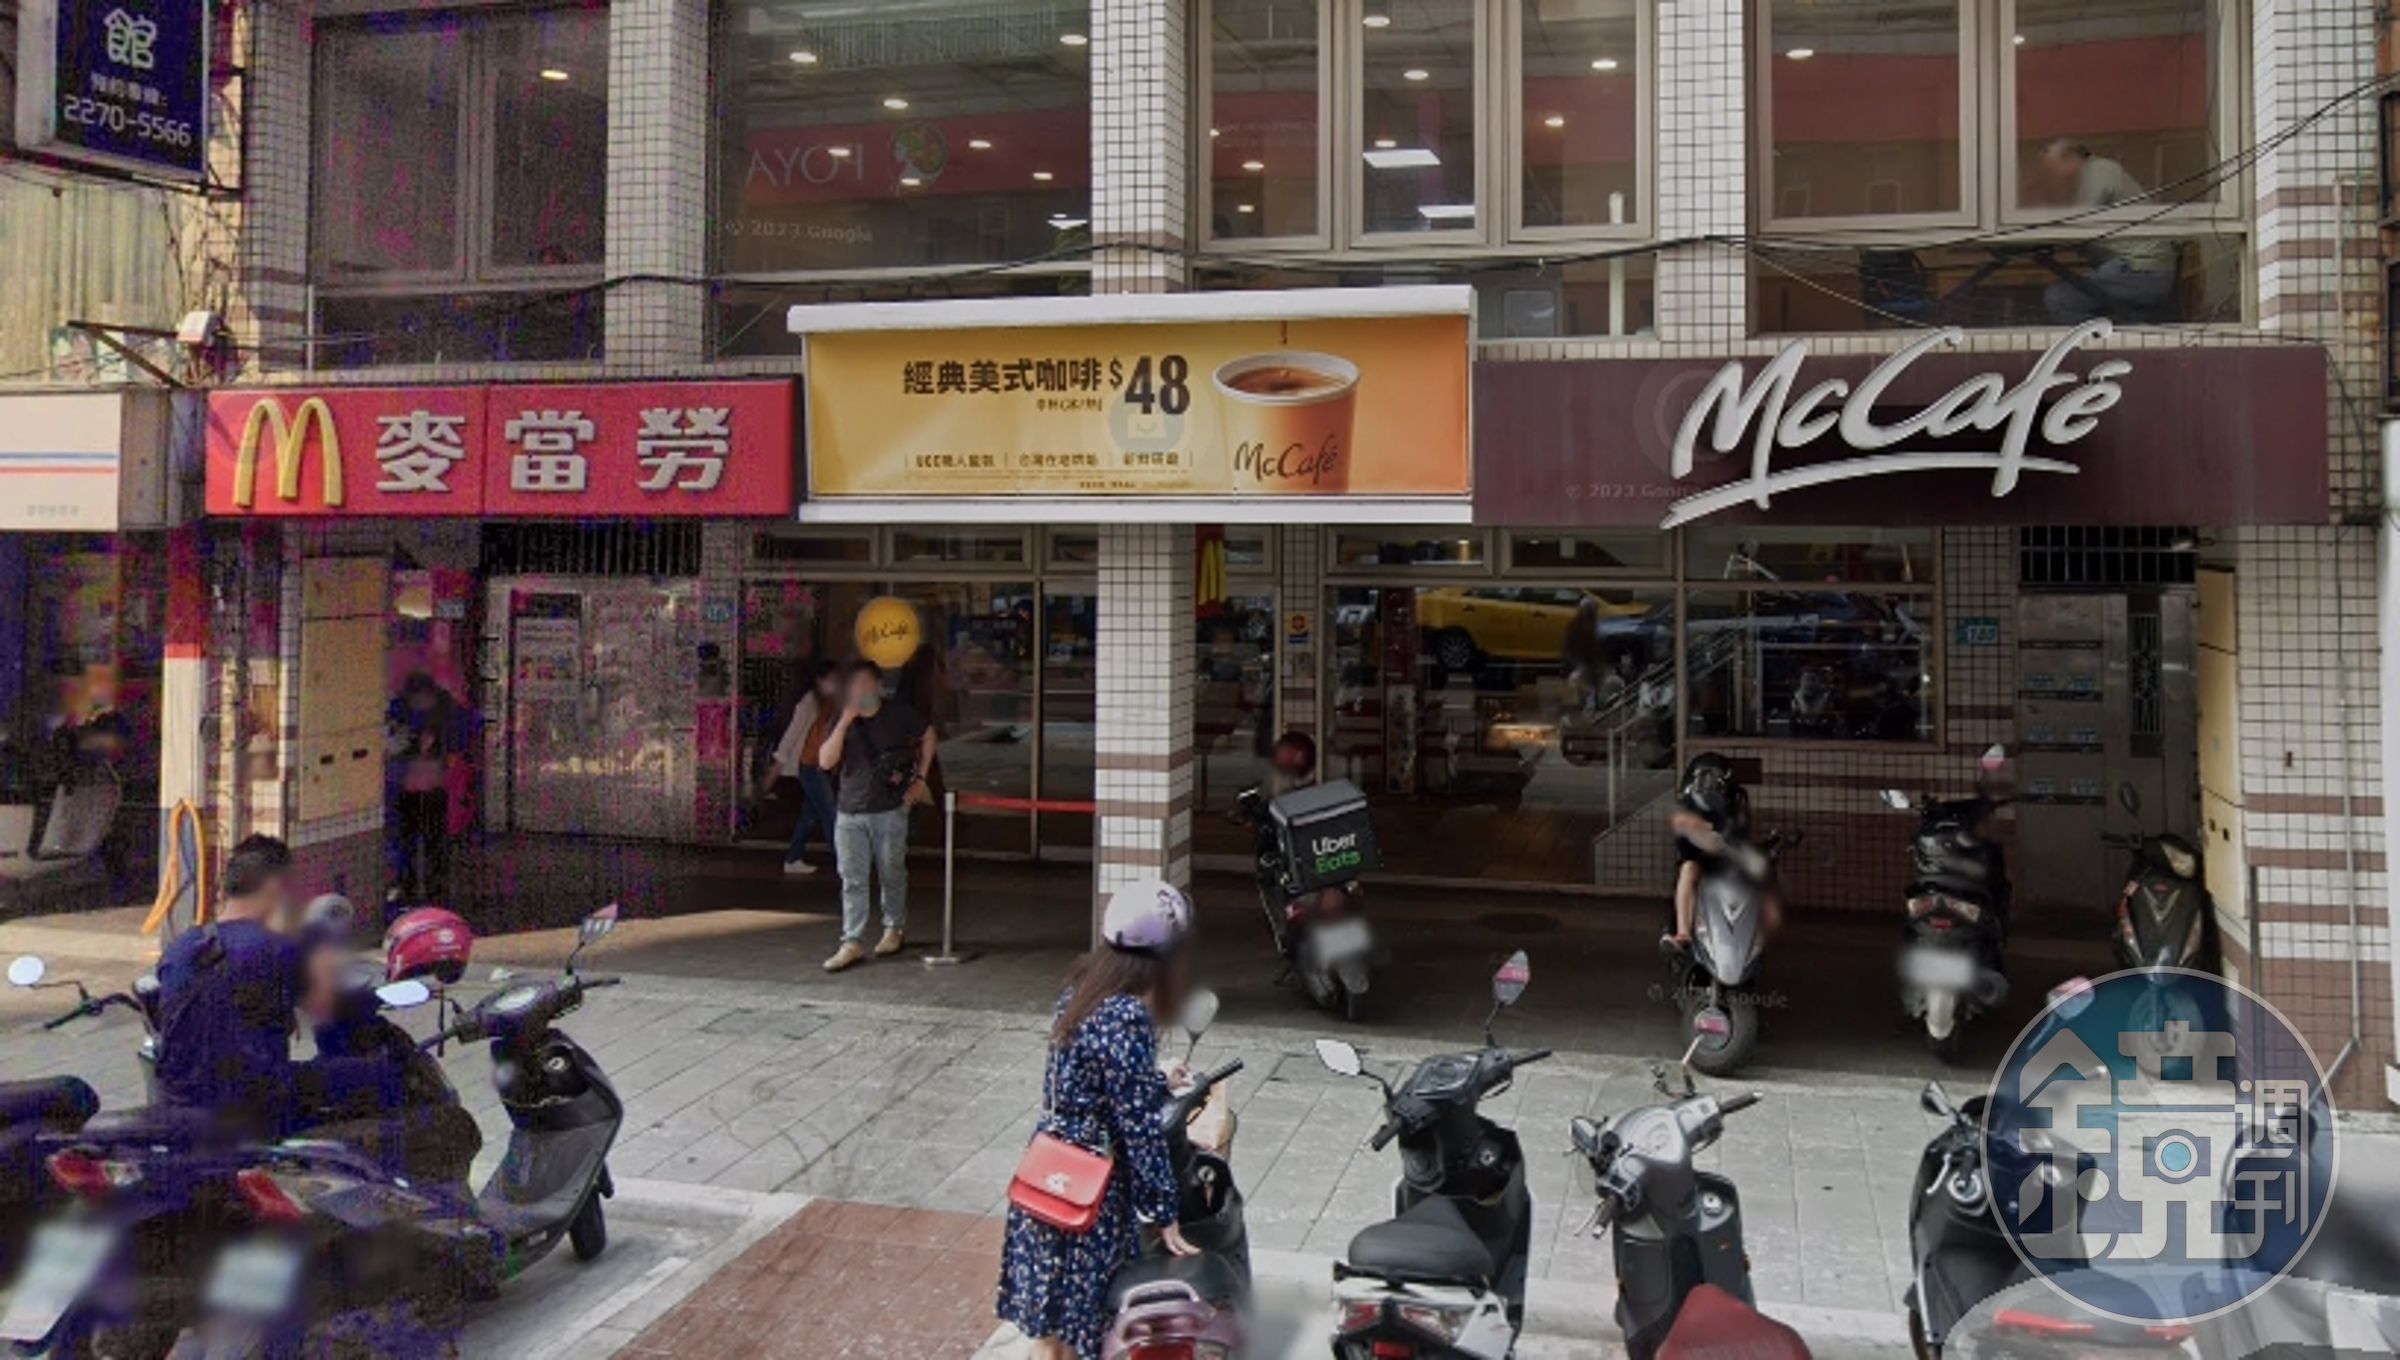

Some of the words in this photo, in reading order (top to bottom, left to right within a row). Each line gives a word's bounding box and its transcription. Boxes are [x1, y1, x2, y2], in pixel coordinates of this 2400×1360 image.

[104, 8, 157, 69] 館
[64, 94, 192, 147] 2270-5566
[903, 357, 1102, 394] 經典美式咖啡
[1671, 316, 2134, 511] McCafé
[374, 407, 733, 492] 麥當勞
[1234, 433, 1338, 485] McCafé
